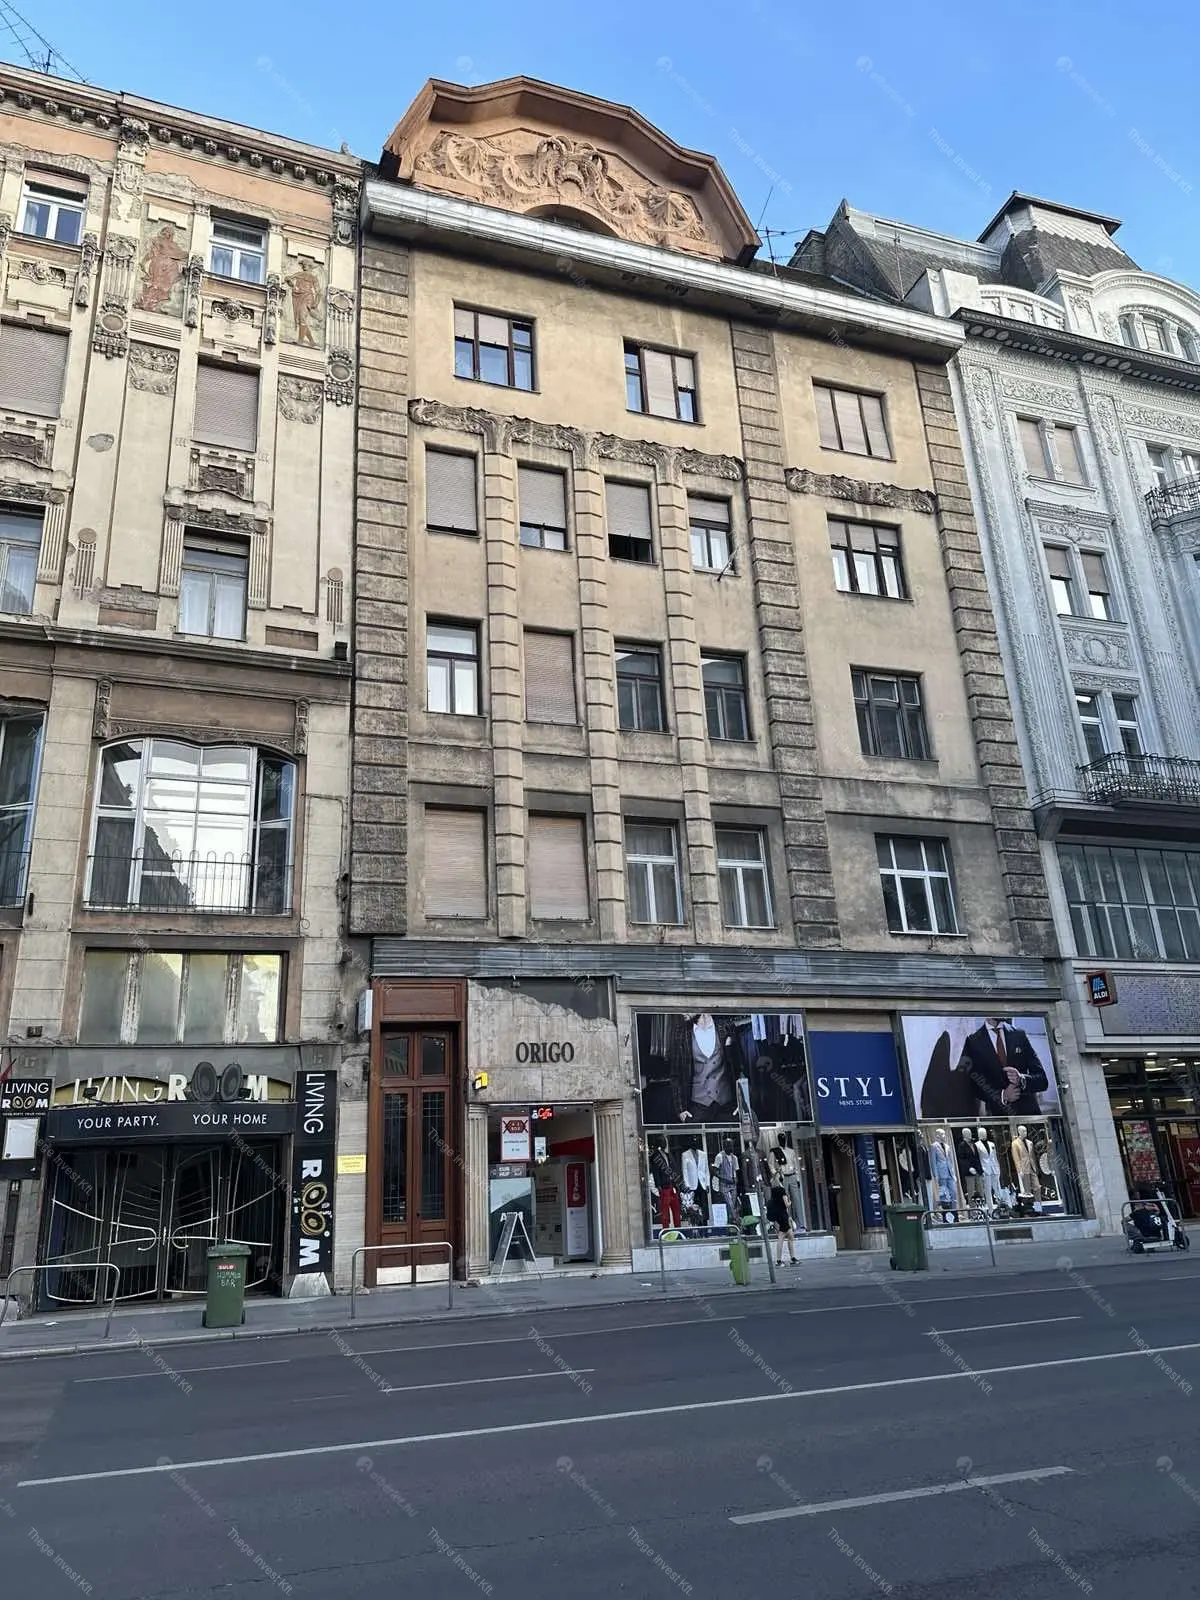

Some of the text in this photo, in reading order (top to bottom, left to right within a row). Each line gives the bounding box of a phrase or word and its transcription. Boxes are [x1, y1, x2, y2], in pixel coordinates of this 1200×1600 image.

[1093, 991, 1108, 1000] ALDI
[515, 1041, 575, 1064] ORIGO
[5, 1082, 49, 1094] LIVING
[167, 1061, 269, 1102] ROOM
[817, 1076, 894, 1098] STYL
[1, 1095, 49, 1110] ROOM
[303, 1073, 326, 1134] LIVING
[77, 1113, 267, 1129] YOUR PARTY. YOUR HOME
[299, 1159, 328, 1267] ROOM
